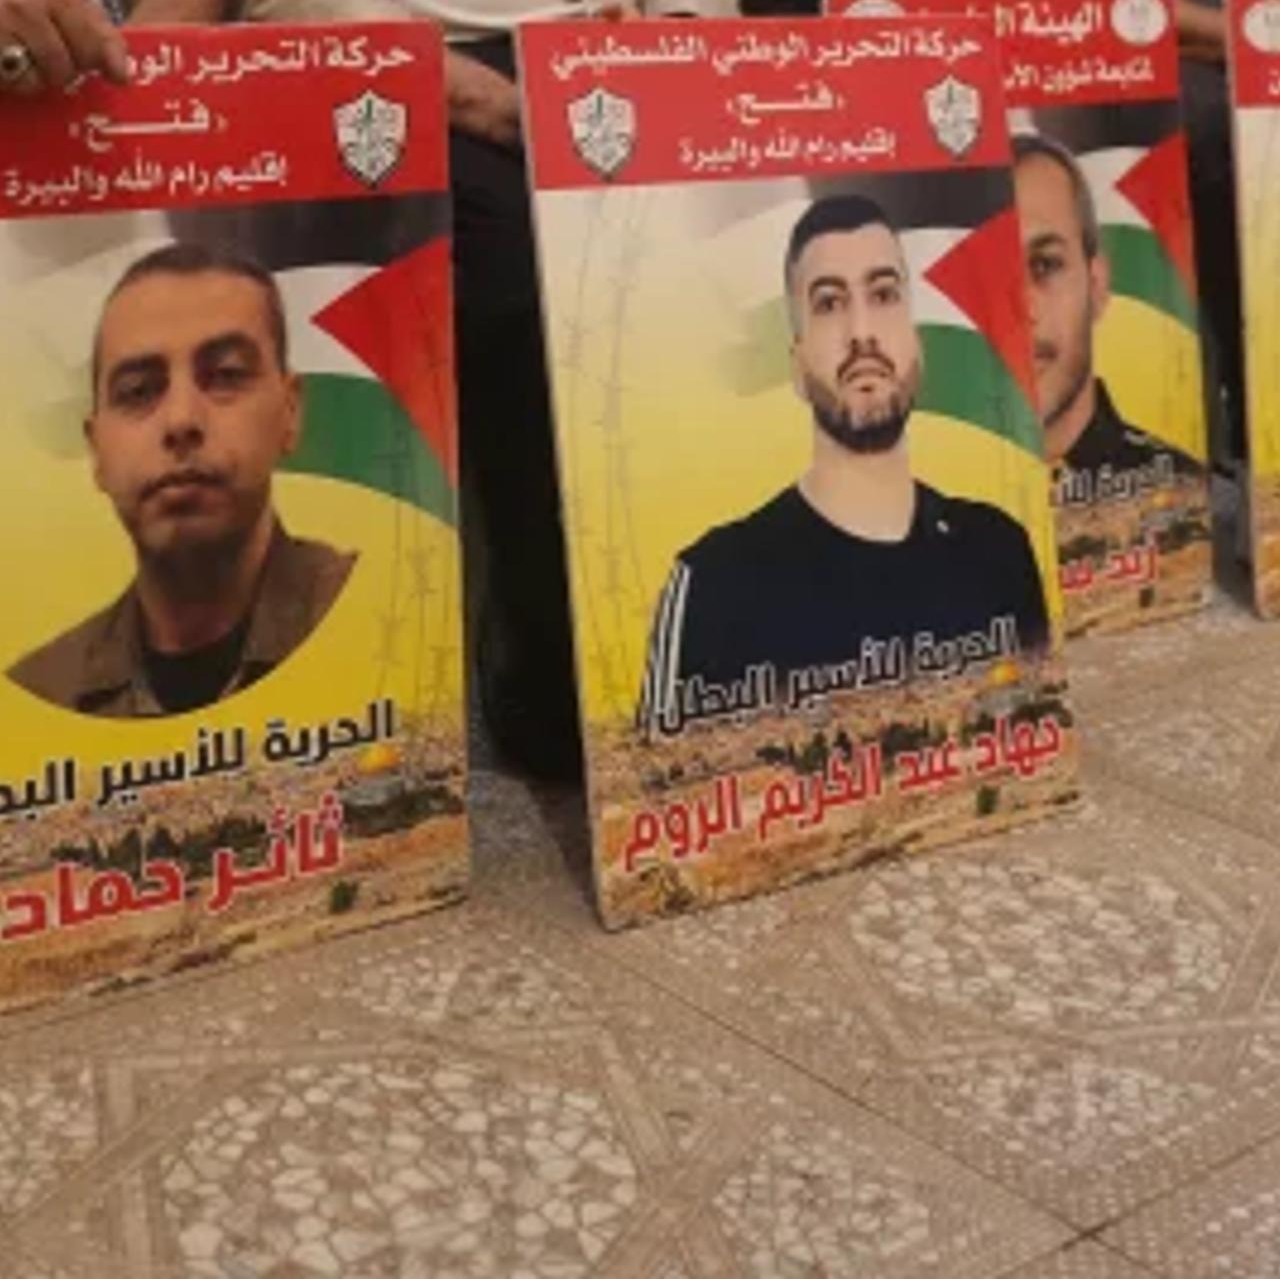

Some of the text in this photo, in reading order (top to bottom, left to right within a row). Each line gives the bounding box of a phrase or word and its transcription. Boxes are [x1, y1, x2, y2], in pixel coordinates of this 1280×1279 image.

[327, 36, 415, 70] حركة
[1017, 1, 1104, 43] الهيئة
[193, 39, 320, 84] التحرير
[550, 28, 982, 80] حركة التحرير الوطني الفلسطيني
[3, 145, 287, 207] إقليم رام الله والبيرة
[678, 128, 896, 170] إقليم رام الله والبيرة
[658, 615, 1017, 738] الحرية للأسير البطل
[263, 698, 395, 763] الحرية
[96, 726, 246, 808] للأسير
[623, 715, 1062, 873] جهاد عبد الكريم الروم
[0, 792, 348, 941] ثائر حماد
